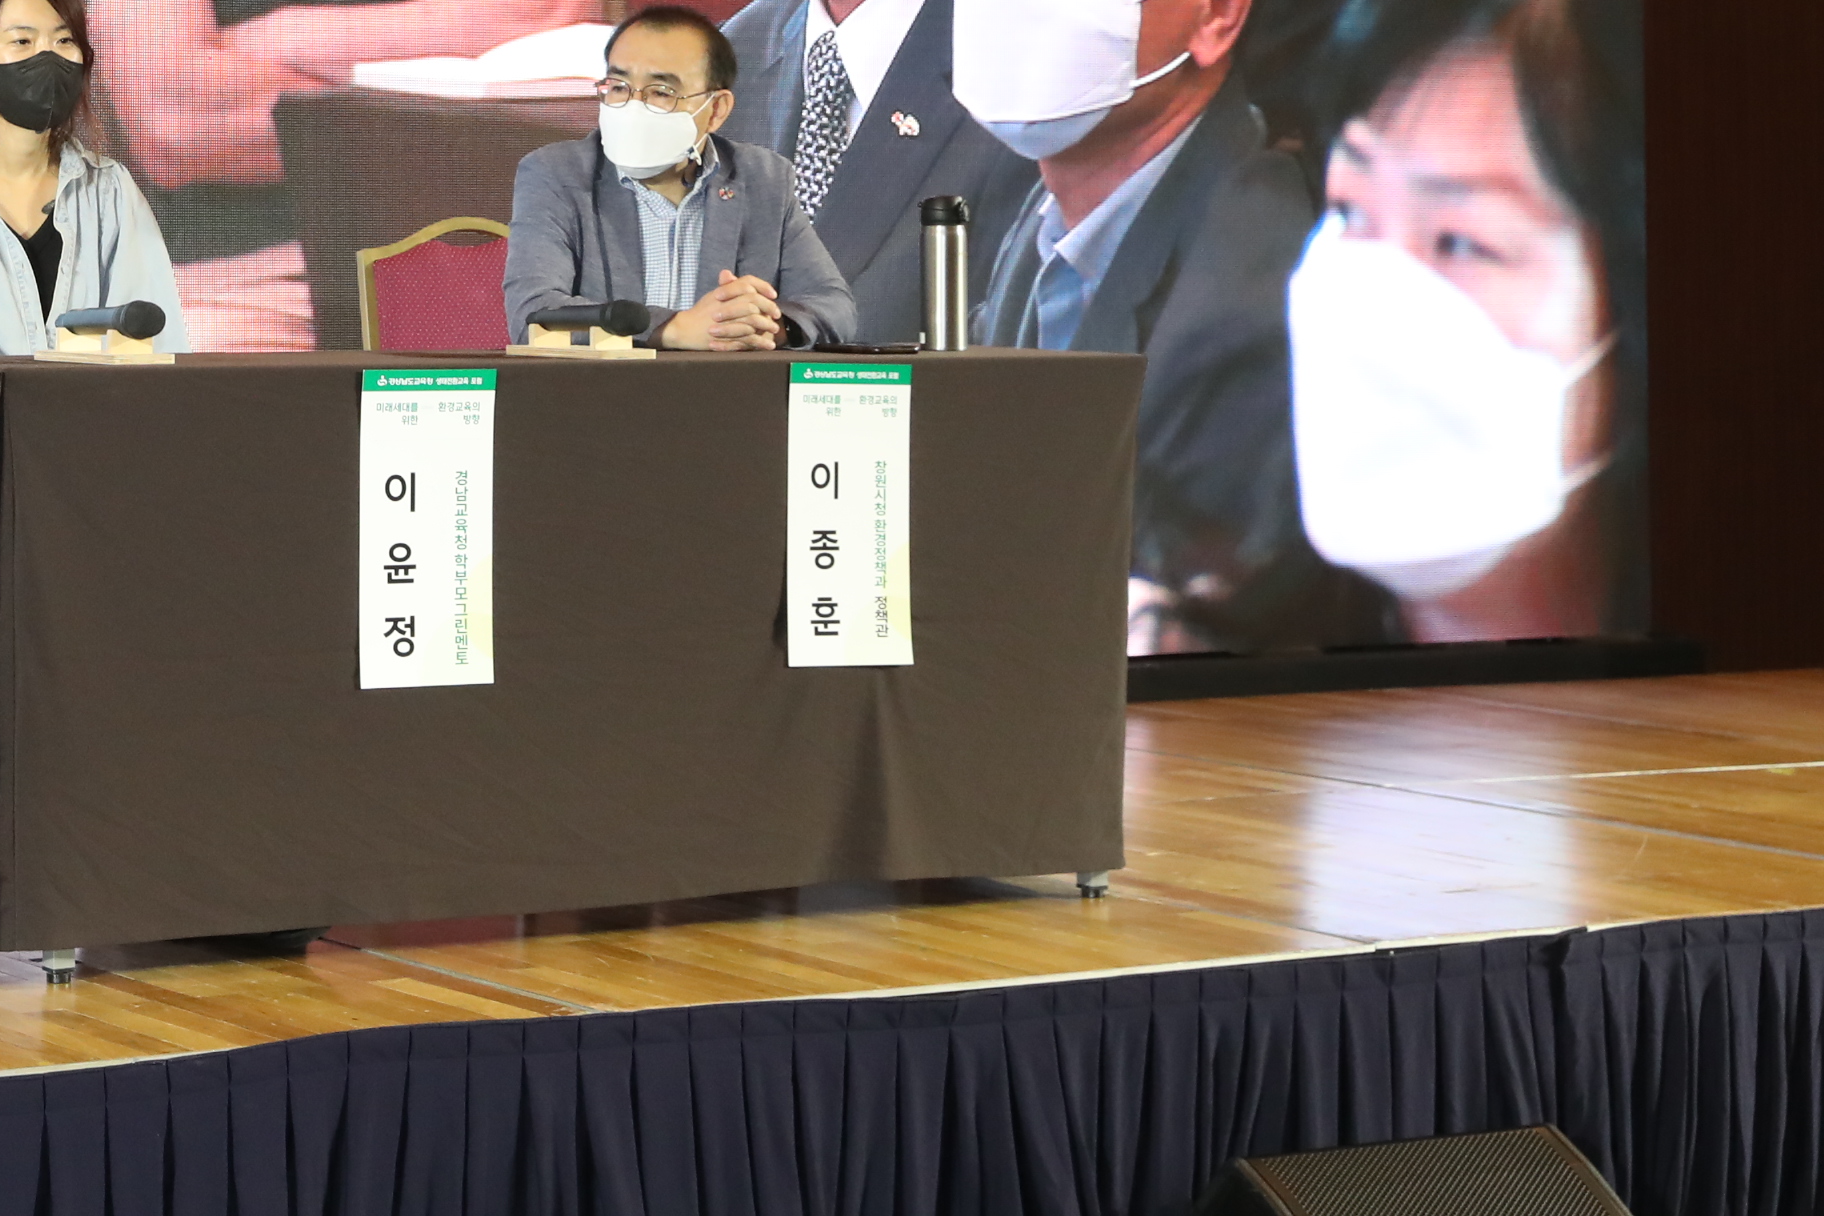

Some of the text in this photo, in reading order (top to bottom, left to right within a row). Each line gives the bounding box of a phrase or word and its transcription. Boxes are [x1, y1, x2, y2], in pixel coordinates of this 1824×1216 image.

[376, 402, 418, 412] 미래세대를
[438, 402, 480, 412] 환경교육의
[401, 415, 418, 425] 위한
[463, 415, 480, 425] 방향
